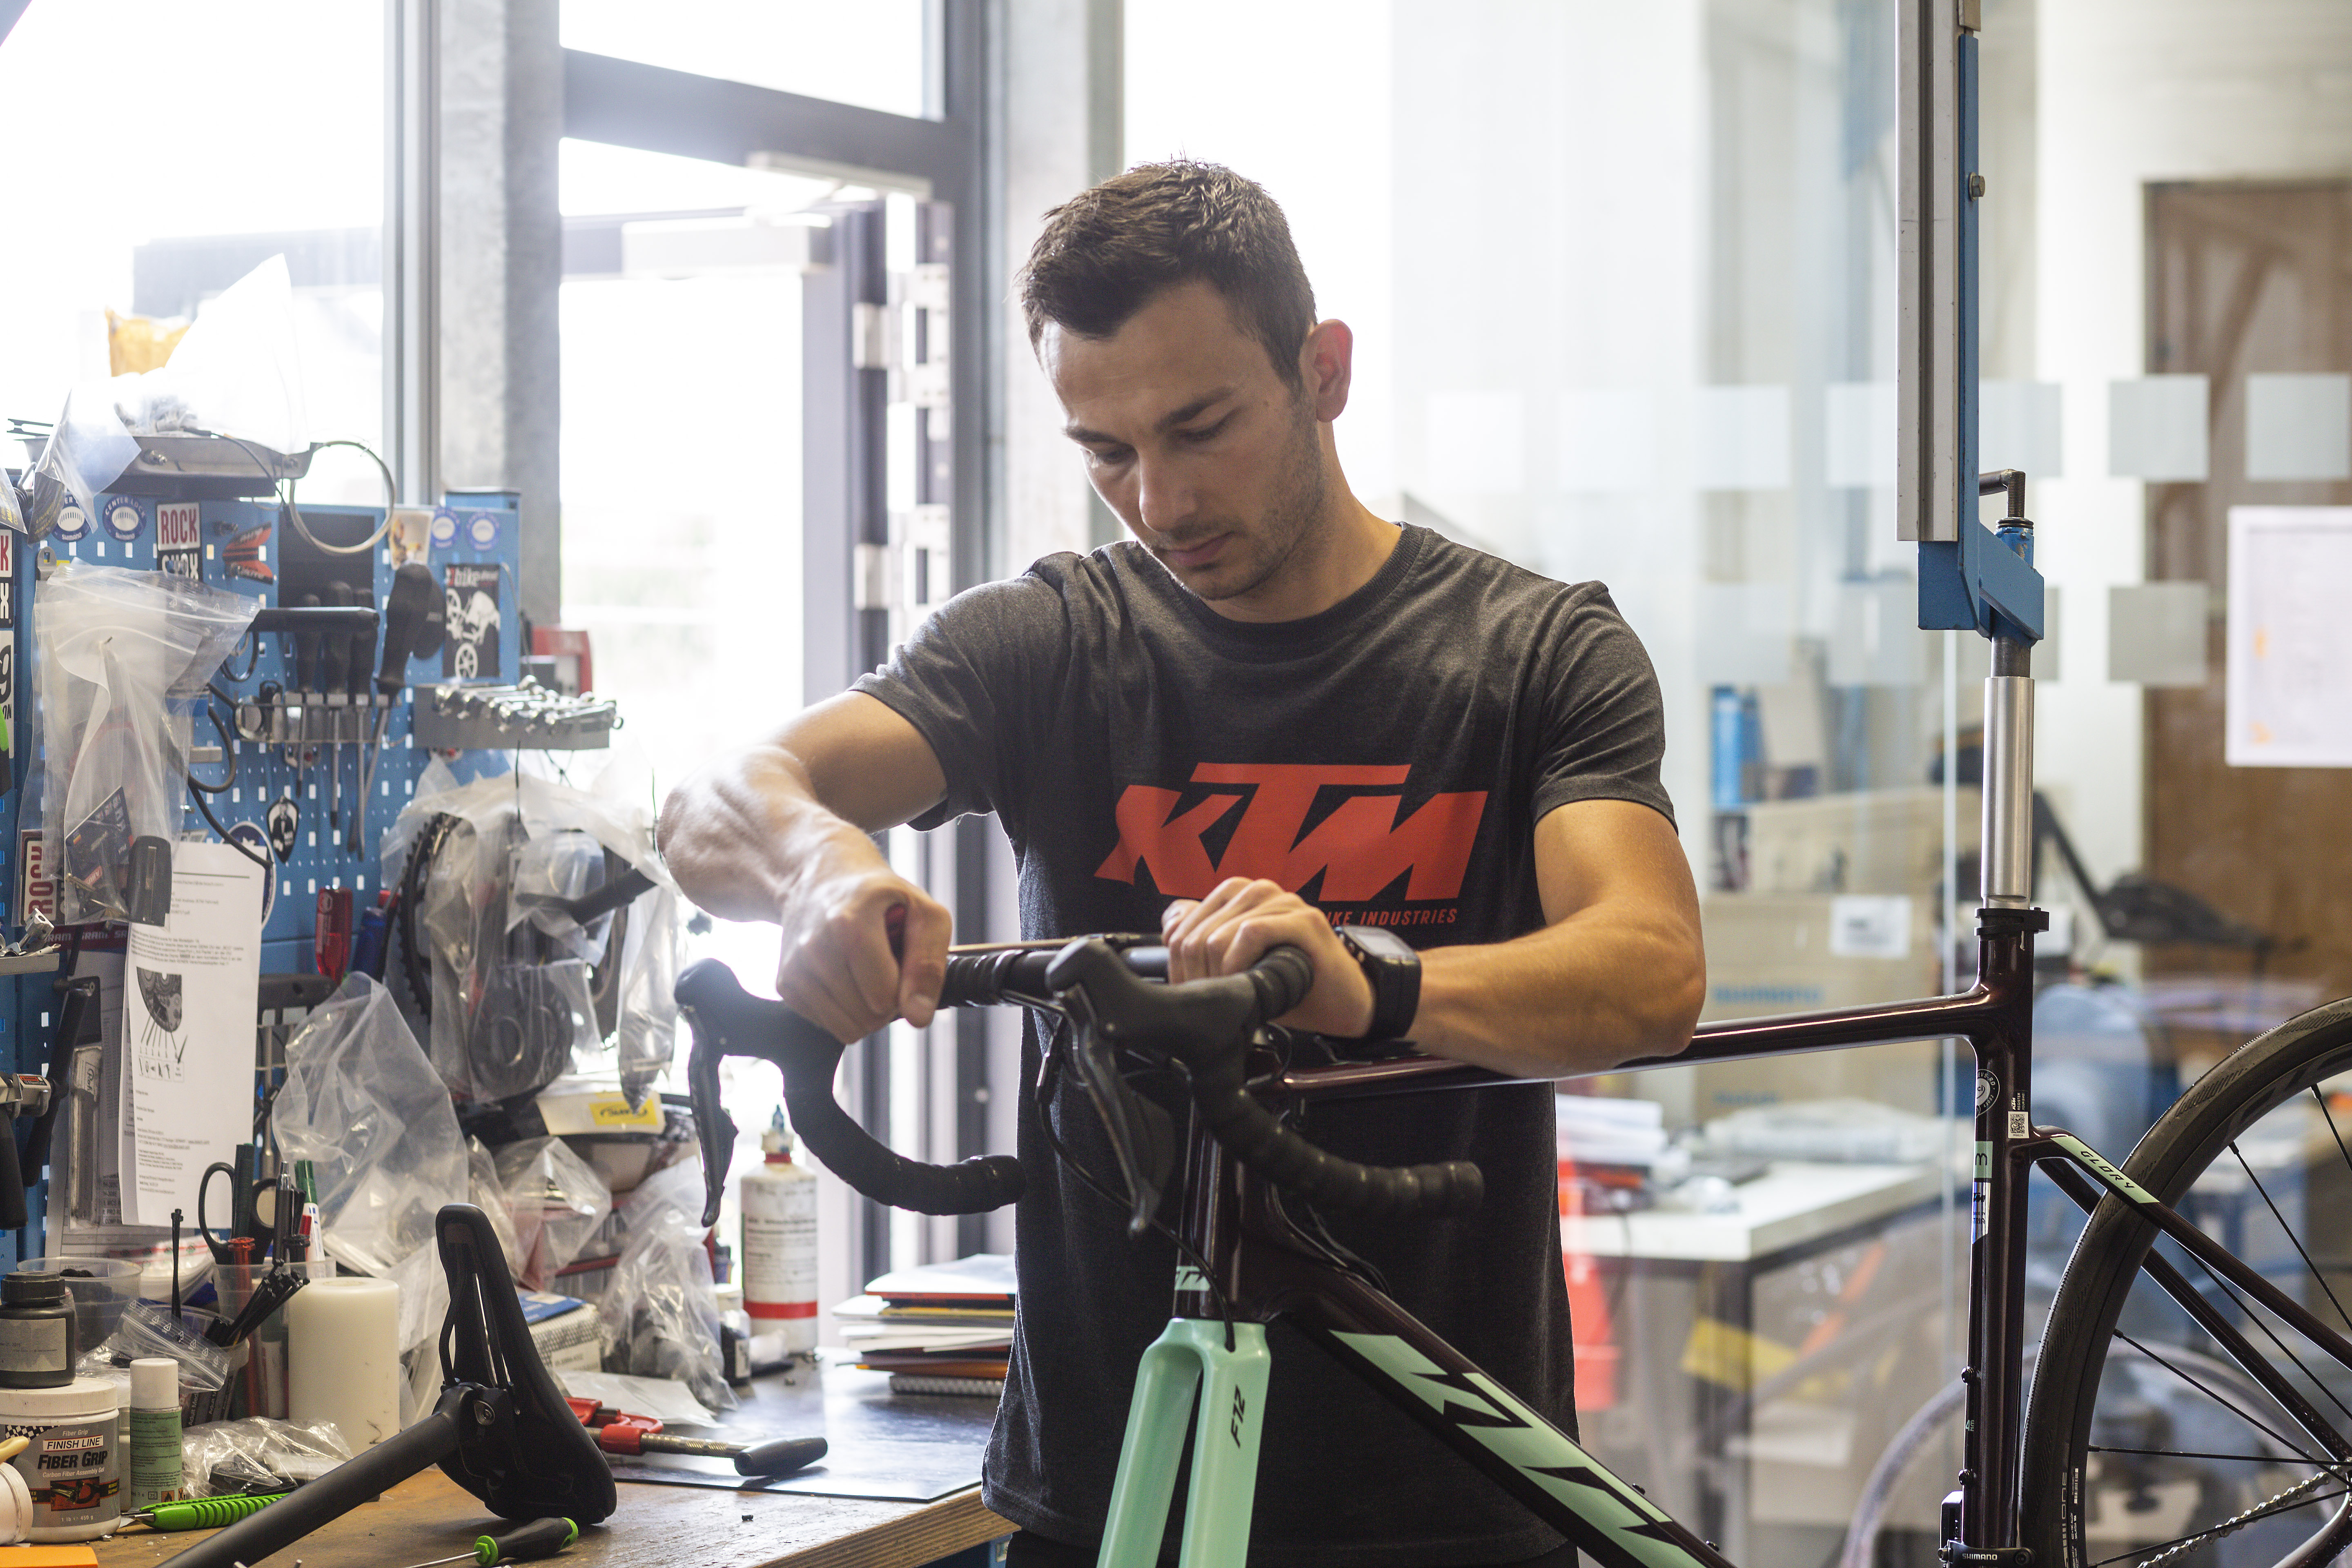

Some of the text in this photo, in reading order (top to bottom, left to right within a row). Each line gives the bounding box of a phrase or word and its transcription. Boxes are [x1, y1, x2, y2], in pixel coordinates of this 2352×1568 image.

[105, 497, 128, 515] CENTER
[160, 509, 197, 544] ROCK
[1094, 762, 1488, 902] KTM
[1327, 908, 1457, 926] IKE INDUSTRIES
[2080, 1151, 2135, 1188] GLORY
[47, 1437, 100, 1450] FINISH LINE
[38, 1450, 108, 1469] FIBER GRIP
